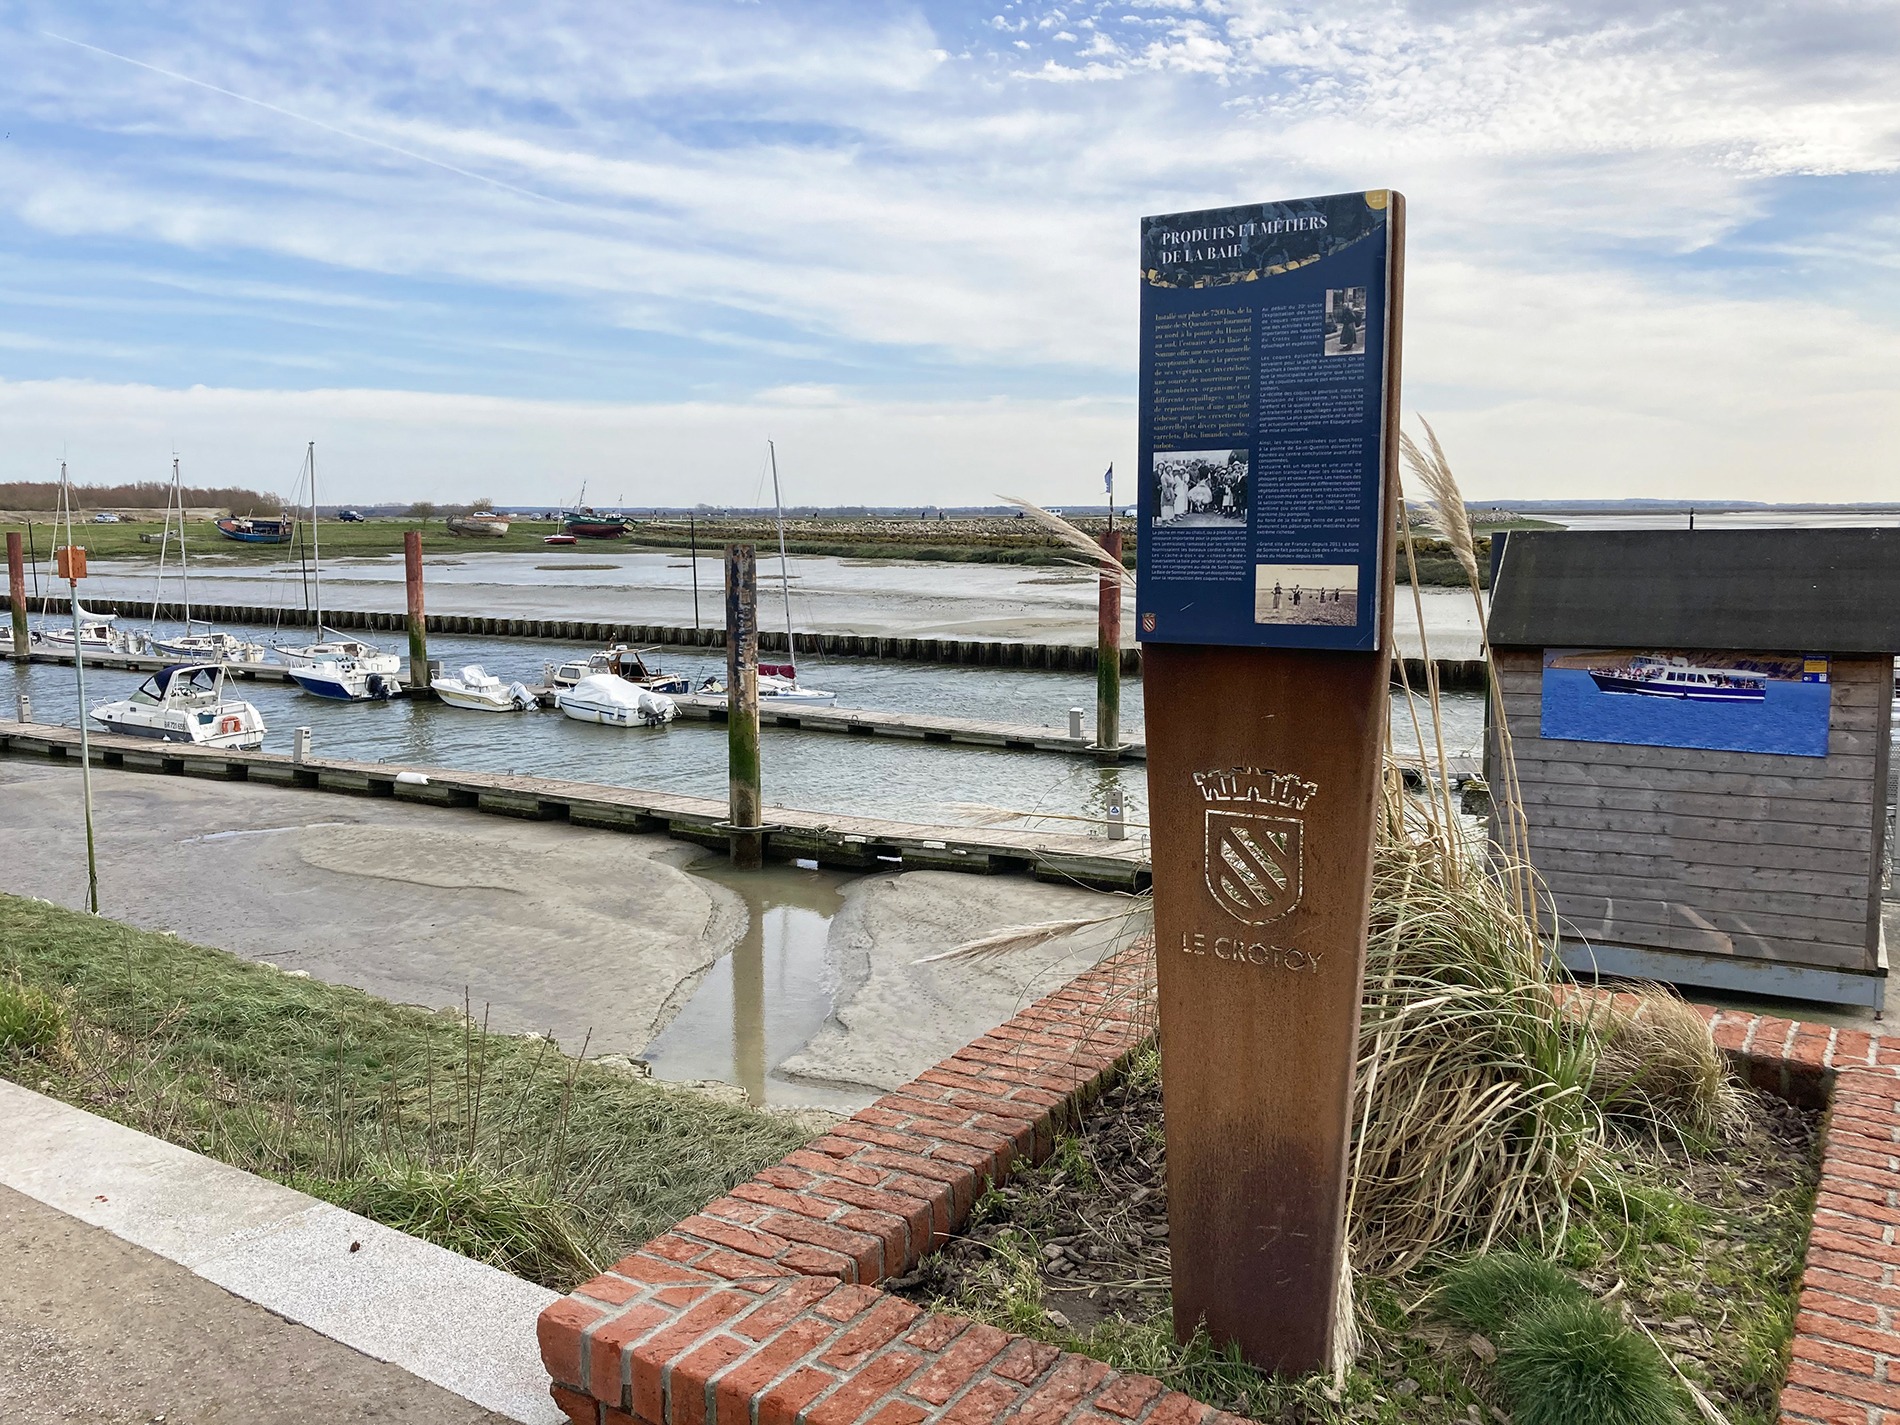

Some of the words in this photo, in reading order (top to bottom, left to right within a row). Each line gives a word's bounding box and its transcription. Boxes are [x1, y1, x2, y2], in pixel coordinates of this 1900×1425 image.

[1162, 225, 1234, 246] PRODUITS
[1238, 224, 1255, 237] ET
[1260, 216, 1328, 234] MÉTIERS
[1162, 250, 1182, 264] DE
[1185, 248, 1202, 262] LA
[1208, 244, 1242, 260] BAIE
[1182, 931, 1205, 956] LE
[1214, 937, 1324, 974] CROTOY
